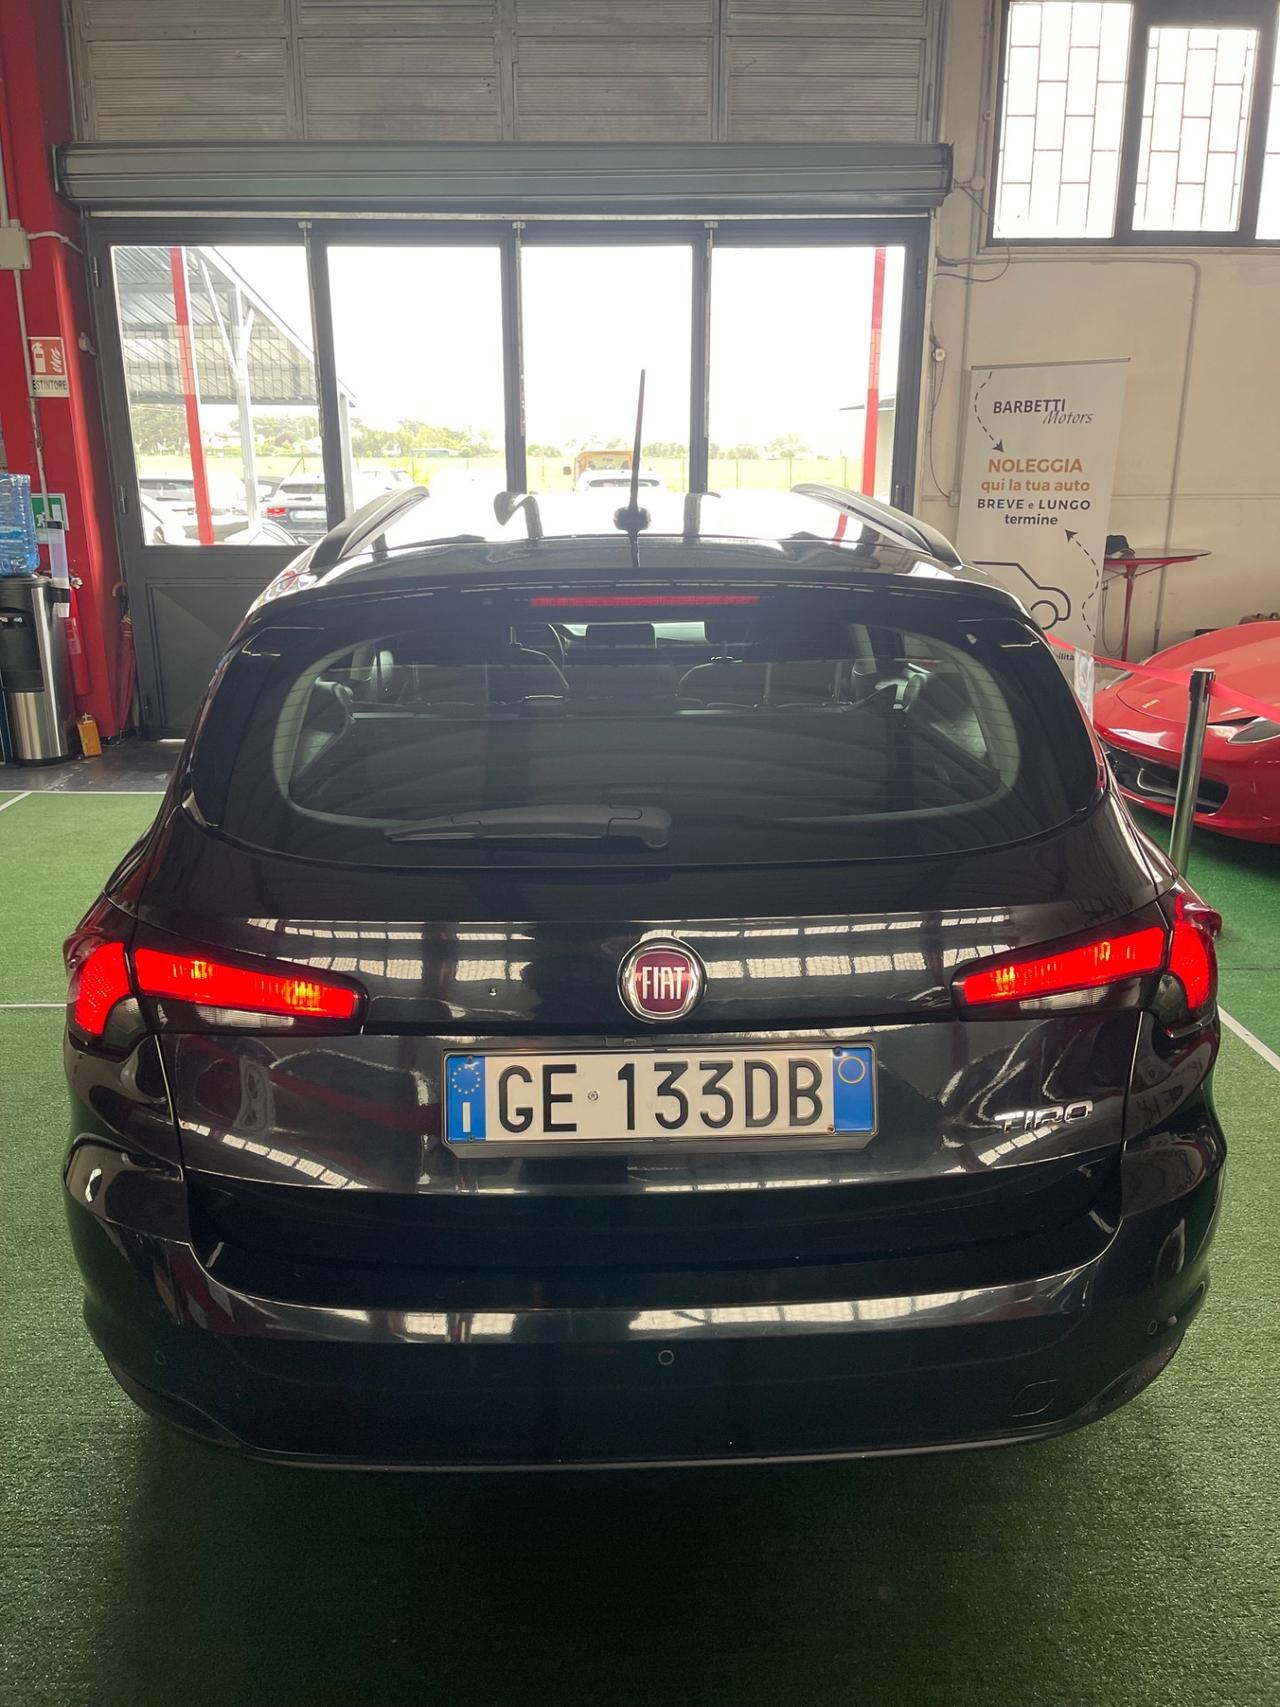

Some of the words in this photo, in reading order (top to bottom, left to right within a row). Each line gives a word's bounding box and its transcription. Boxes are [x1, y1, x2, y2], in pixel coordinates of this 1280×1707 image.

[32, 379, 67, 391] ESTINTORE
[993, 399, 1066, 414] BARBETTI
[1042, 411, 1094, 425] Motors
[988, 459, 1083, 473] NOLEGGIA
[981, 479, 1005, 493] qui
[1009, 479, 1022, 491] la
[1025, 480, 1050, 491] tua
[1054, 480, 1090, 492] auto
[977, 499, 1025, 509] BREVE
[1039, 499, 1091, 510] LUNGO
[1005, 514, 1058, 525] termine
[642, 966, 686, 1000] FIAT
[499, 1063, 578, 1134] GE
[617, 1057, 823, 1131] 133DB
